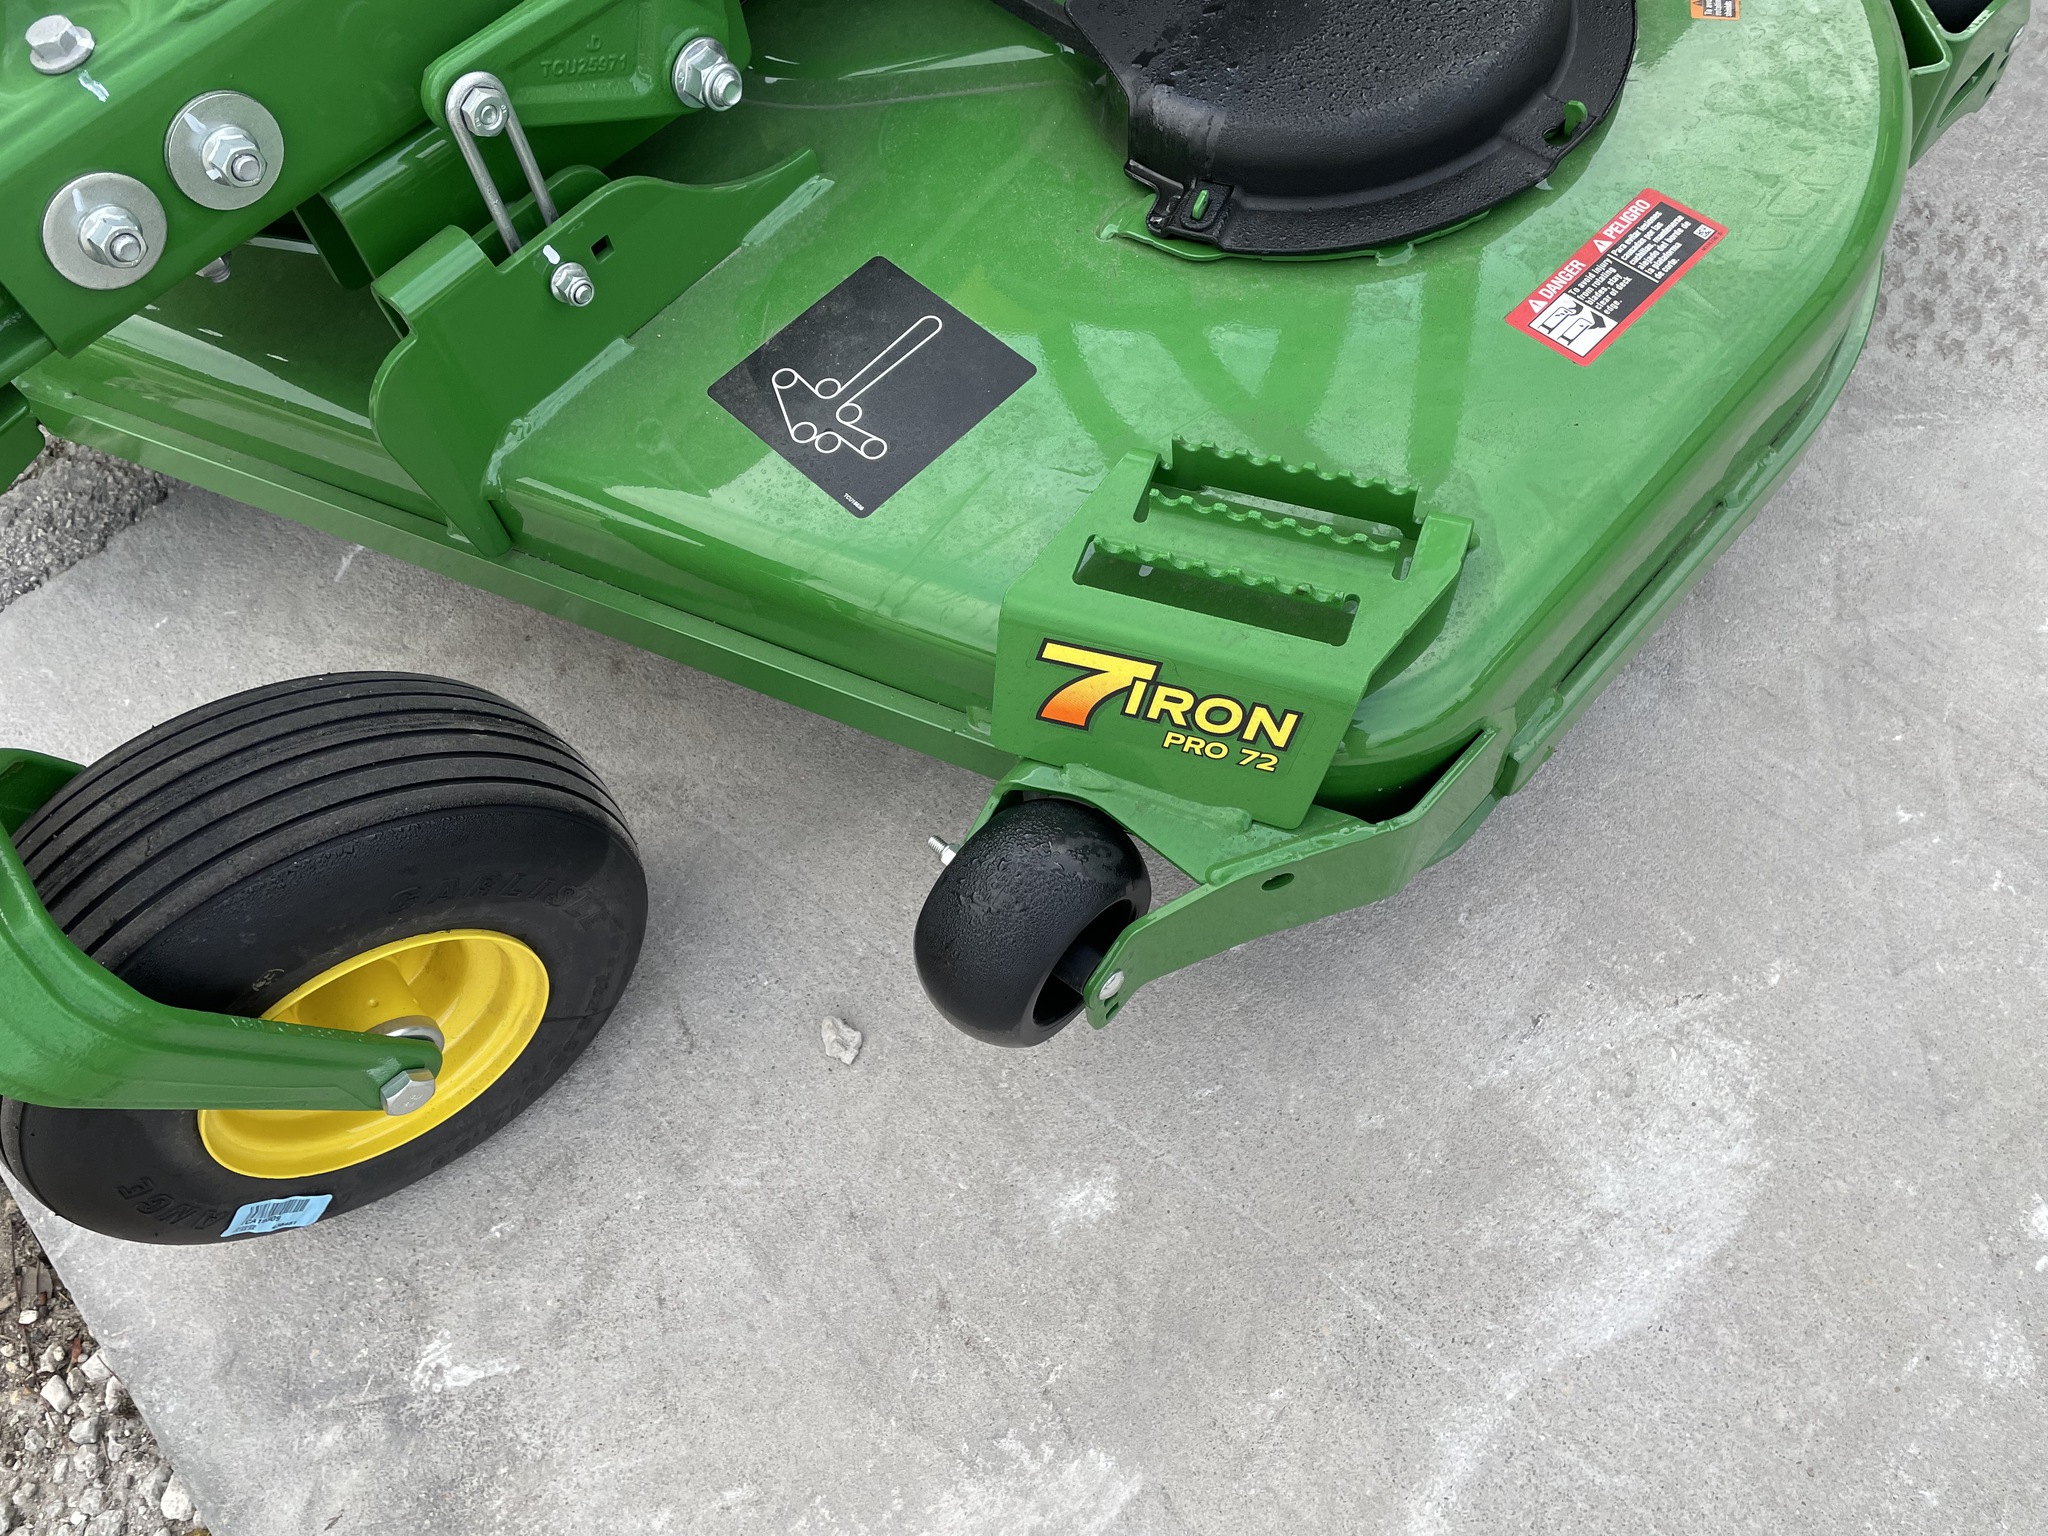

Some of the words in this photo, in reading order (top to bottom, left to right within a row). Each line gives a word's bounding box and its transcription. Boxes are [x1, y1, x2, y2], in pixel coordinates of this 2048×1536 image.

[541, 53, 627, 78] TCU25971
[1602, 199, 1651, 240] PELIGRO
[1610, 243, 1628, 256] Para
[1624, 230, 1642, 245] evitar
[1636, 210, 1662, 232] lesiones
[1620, 237, 1647, 260] causadas
[1643, 229, 1655, 240] por
[1650, 222, 1664, 231] las
[1629, 243, 1656, 265] cuchillas,
[1652, 215, 1684, 243] mantenerse
[1637, 250, 1660, 270] alejado
[1656, 240, 1669, 252] del
[1664, 225, 1686, 243] borde
[1680, 220, 1692, 228] de
[1651, 242, 1682, 270] plataforma
[1538, 259, 1586, 300] DANGER
[1568, 287, 1580, 295] To
[1578, 272, 1596, 288] avoid
[1591, 258, 1612, 274] injury
[1576, 286, 1594, 300] from
[1591, 266, 1617, 288] rotating
[1654, 269, 1665, 279] de
[1661, 258, 1680, 272] corte.
[1584, 286, 1610, 305] blades,
[1607, 271, 1622, 286] stay
[1594, 294, 1612, 310] clear
[1609, 288, 1618, 296] of
[1615, 276, 1632, 290] deck
[1603, 300, 1622, 314] edge.
[1162, 731, 1229, 760] PRO
[1236, 748, 1280, 773] 72
[384, 872, 611, 932] CARLISLE
[115, 1176, 232, 1230] ANGE
